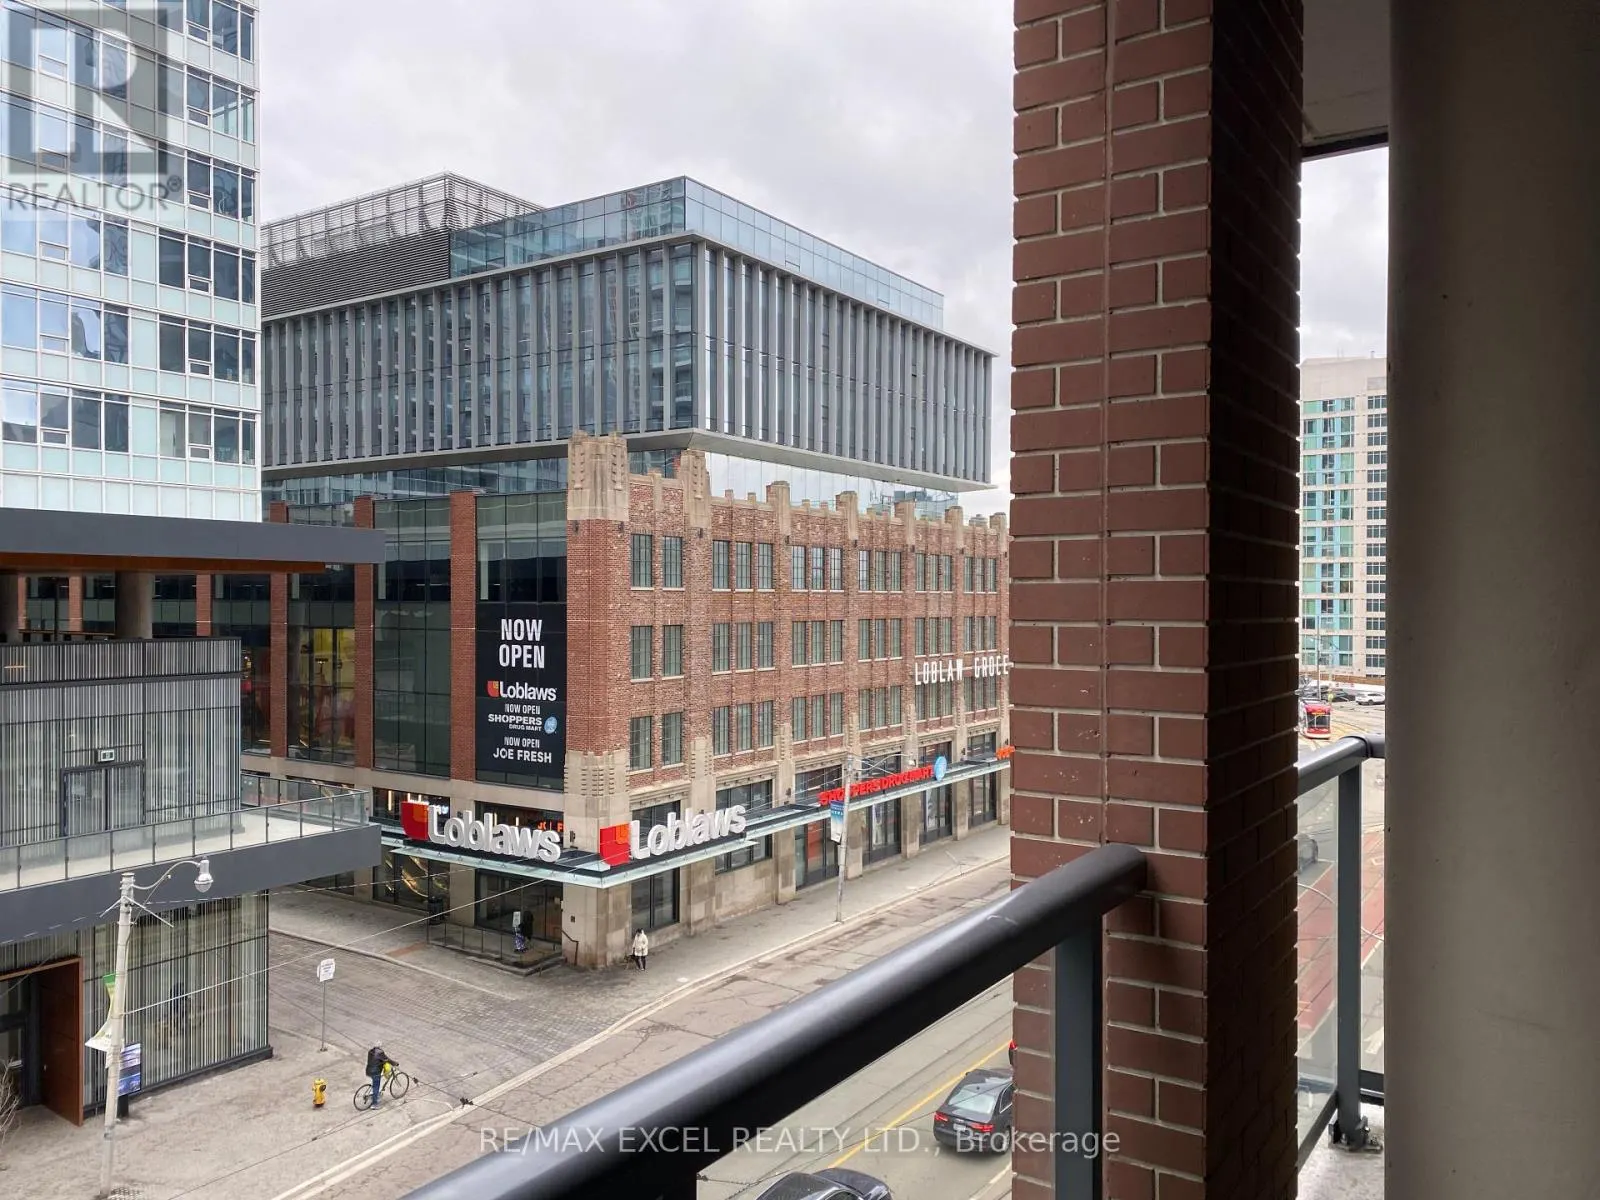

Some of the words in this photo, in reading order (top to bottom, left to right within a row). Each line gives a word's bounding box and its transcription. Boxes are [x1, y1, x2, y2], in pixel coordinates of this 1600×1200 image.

[501, 618, 543, 642] NOW
[499, 643, 545, 669] OPEN
[915, 658, 964, 686] LOBLAW
[499, 680, 557, 701] Loblaws
[488, 713, 543, 726] SHOPPERS
[504, 703, 520, 714] NOW
[522, 704, 541, 715] OPEN
[508, 723, 525, 731] DRUG
[526, 724, 542, 732] MART
[504, 736, 520, 747] NOW
[522, 737, 540, 749] OPEN
[493, 747, 514, 760] JOE
[517, 749, 552, 764] FRESH
[817, 779, 881, 806] SHOPERS
[428, 804, 561, 863] Loblaws
[629, 804, 747, 860] Loblaws
